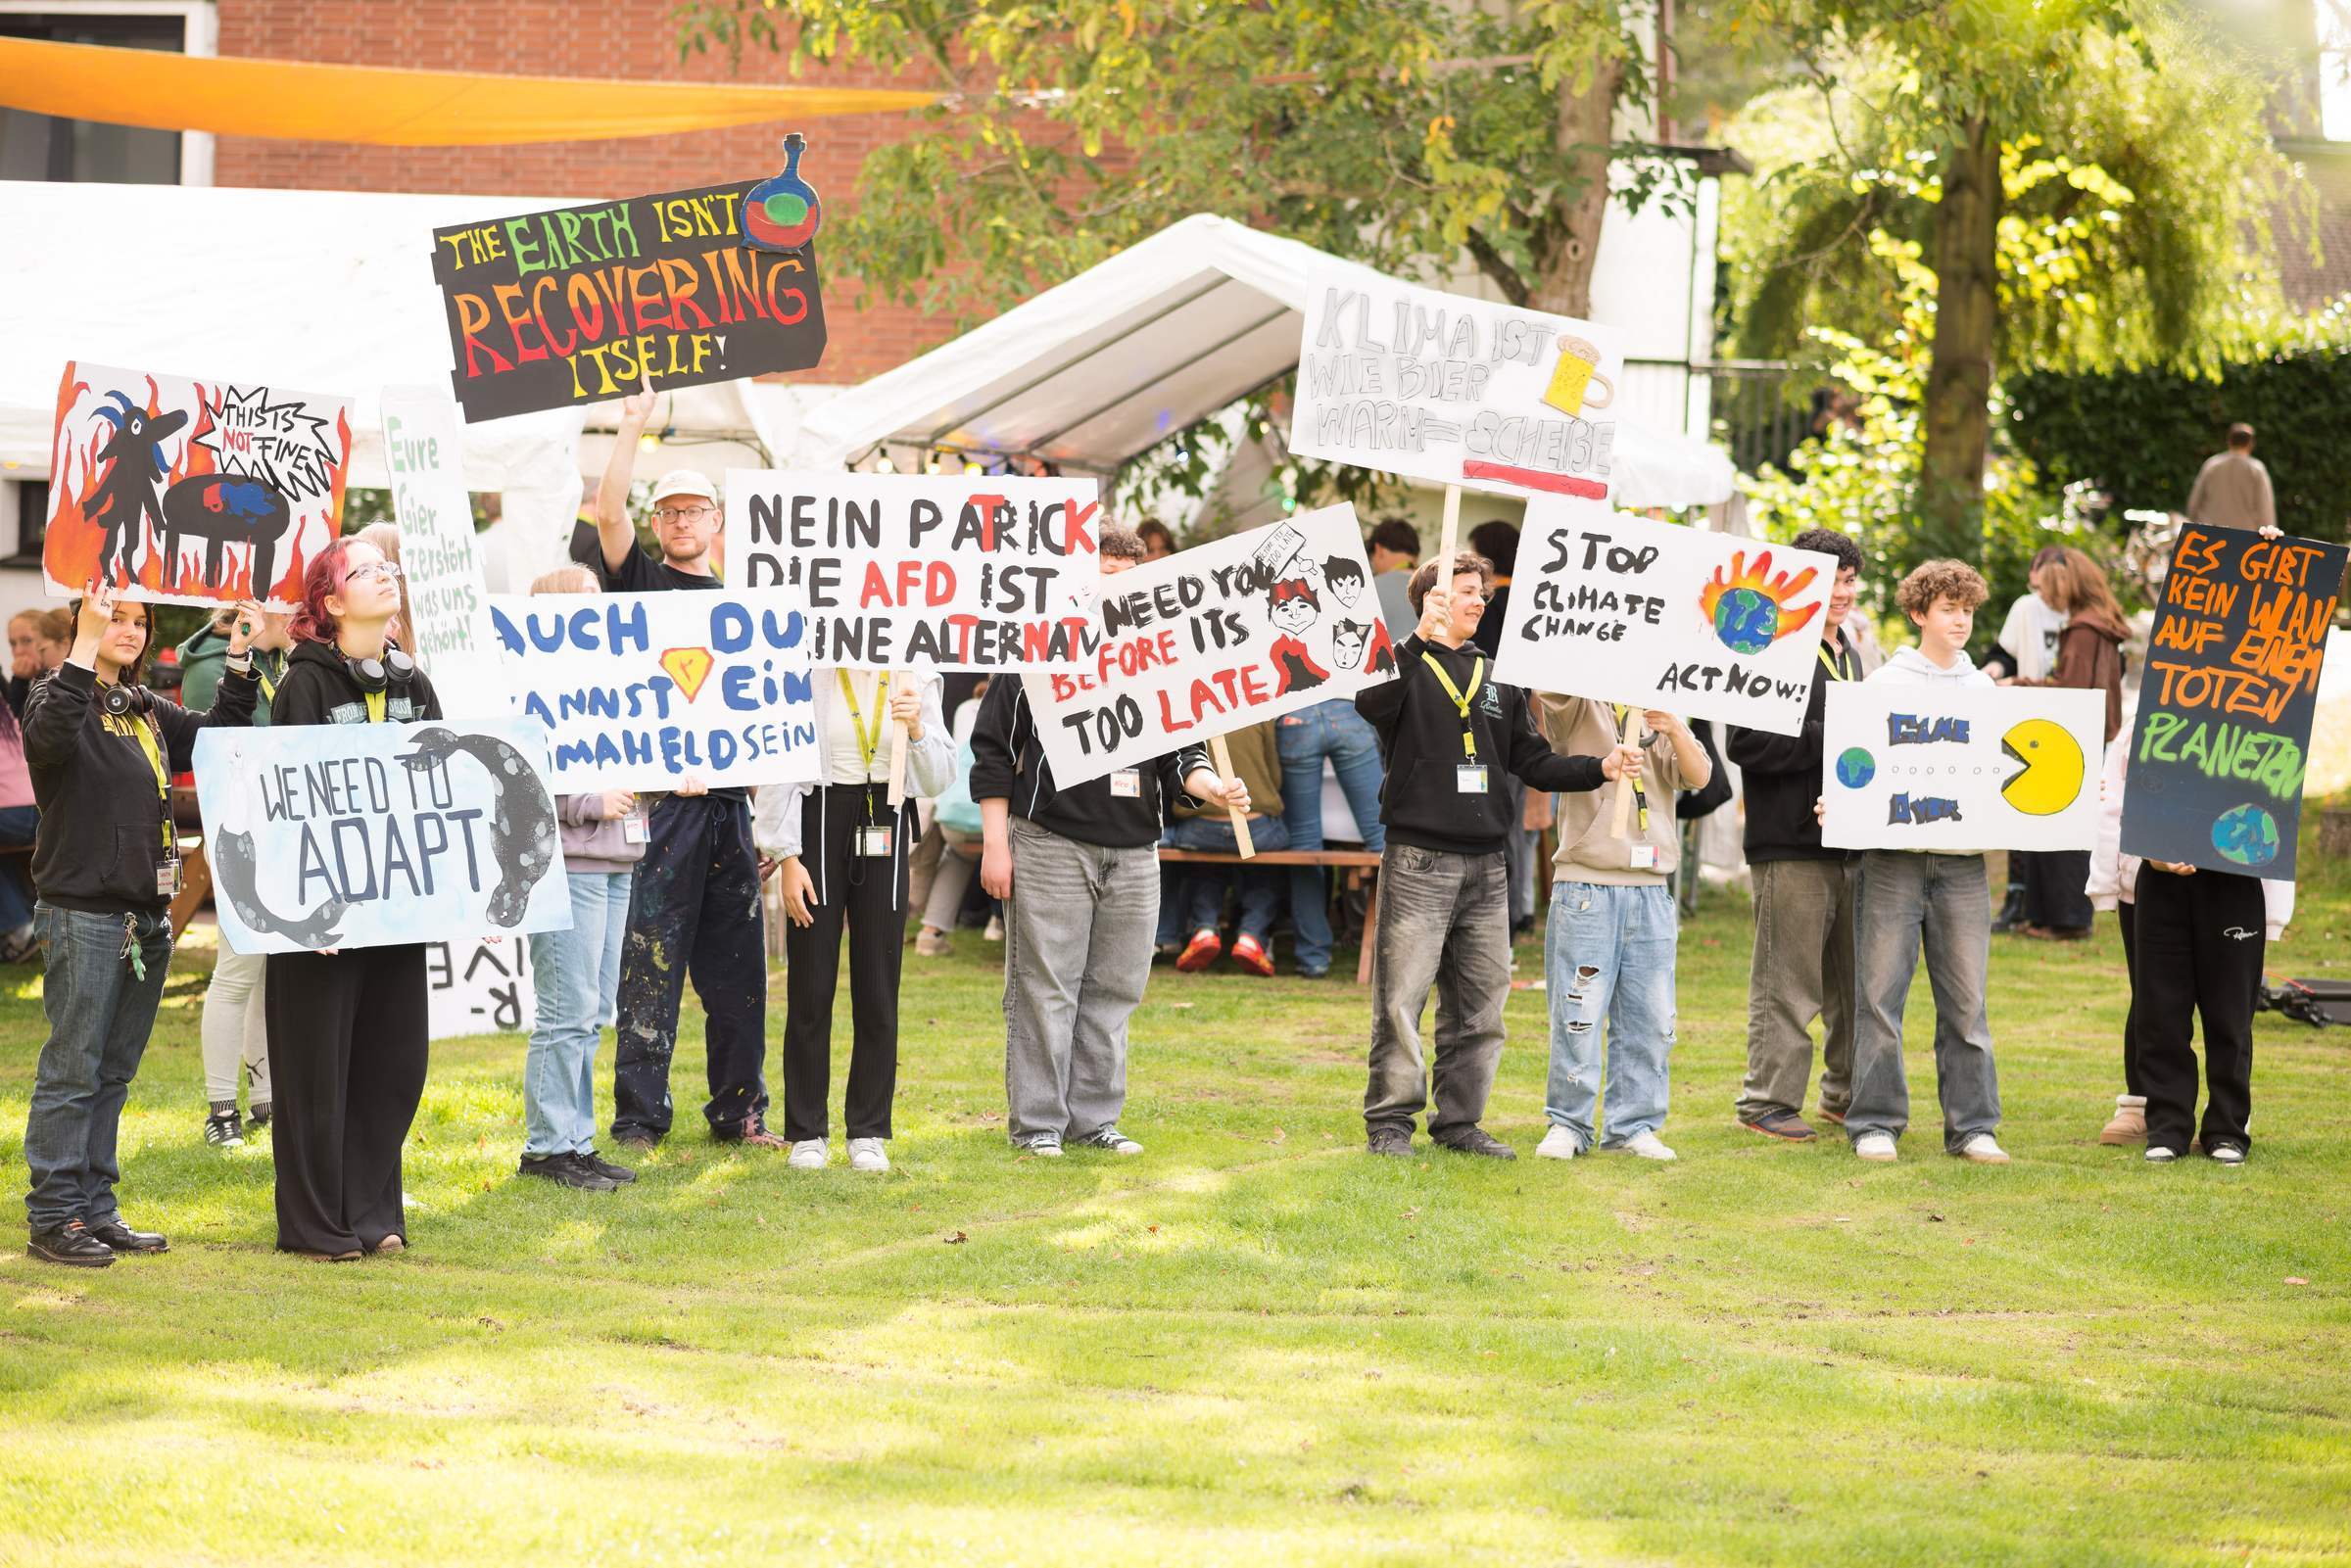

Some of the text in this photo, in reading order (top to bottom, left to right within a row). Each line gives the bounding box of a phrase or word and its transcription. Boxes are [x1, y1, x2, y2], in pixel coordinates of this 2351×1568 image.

[439, 192, 739, 276] THE EARTH ISN'T
[455, 247, 808, 377] RECOVERING
[1316, 288, 1556, 366] KLIMA IST
[566, 333, 727, 399] ITSELF!
[1308, 354, 1490, 402] WIE BIER
[225, 404, 295, 433] THIS IS
[387, 415, 440, 473] Eure
[222, 427, 312, 470] NOT FINE
[399, 482, 437, 537] Gier
[748, 494, 1098, 555] NEIN PATRICK
[406, 532, 472, 584] zerstört
[1540, 529, 1659, 574] STOP
[2174, 531, 2326, 587] ES GIBT
[412, 584, 477, 620] was uns
[747, 552, 1060, 614] DIE AFD IST
[1102, 555, 1277, 638] NEED YOU
[2168, 573, 2337, 643] KEIN WLAN
[419, 615, 475, 676] gehört!
[710, 601, 803, 654] DU
[805, 616, 892, 664] INE
[1189, 607, 1250, 653] ITS
[1521, 614, 1627, 641] CHANGE
[2155, 615, 2227, 654] AUF
[510, 676, 674, 730] ANNST
[1062, 664, 1271, 756] TOO LATE
[1656, 662, 1807, 703] ACT NOW!
[2151, 660, 2298, 725] TOTEN
[1887, 711, 1970, 747] GAME
[260, 750, 453, 822] WE NEED TO
[298, 808, 483, 905] ADAPT
